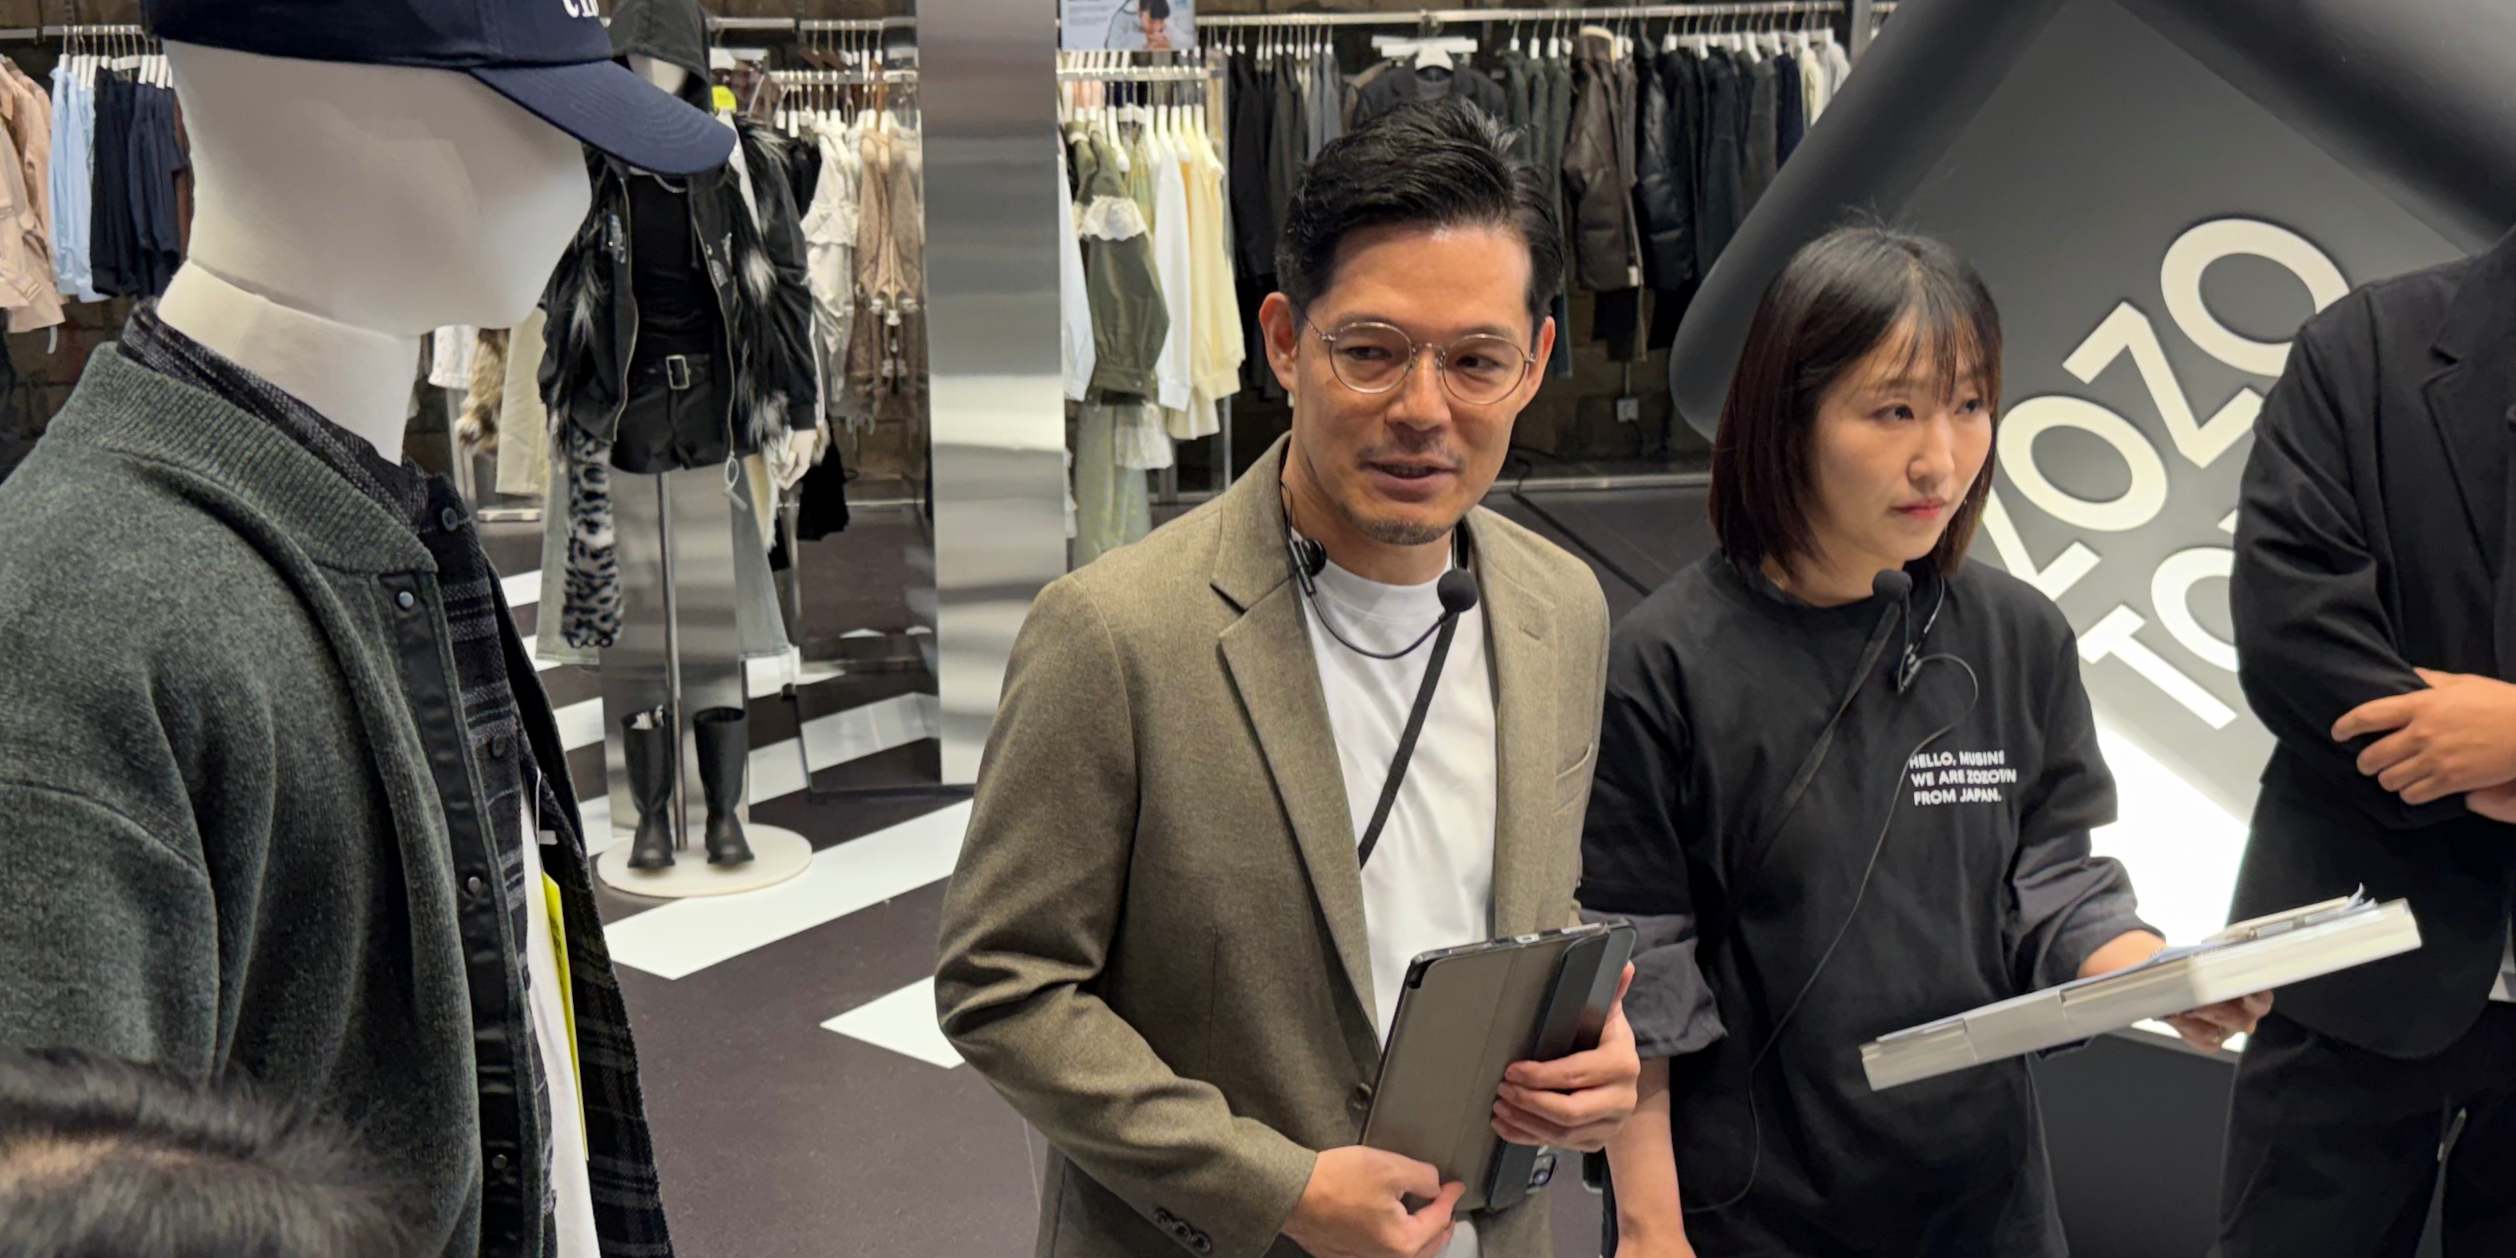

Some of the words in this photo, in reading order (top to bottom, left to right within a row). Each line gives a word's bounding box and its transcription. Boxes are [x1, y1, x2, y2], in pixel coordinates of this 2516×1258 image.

[1909, 751, 1957, 769] HELLO,
[1910, 771, 1935, 787] WE
[1939, 769, 1965, 785] ARE
[1913, 788, 1957, 806] FROM
[1960, 786, 2002, 802] JAPAN.
